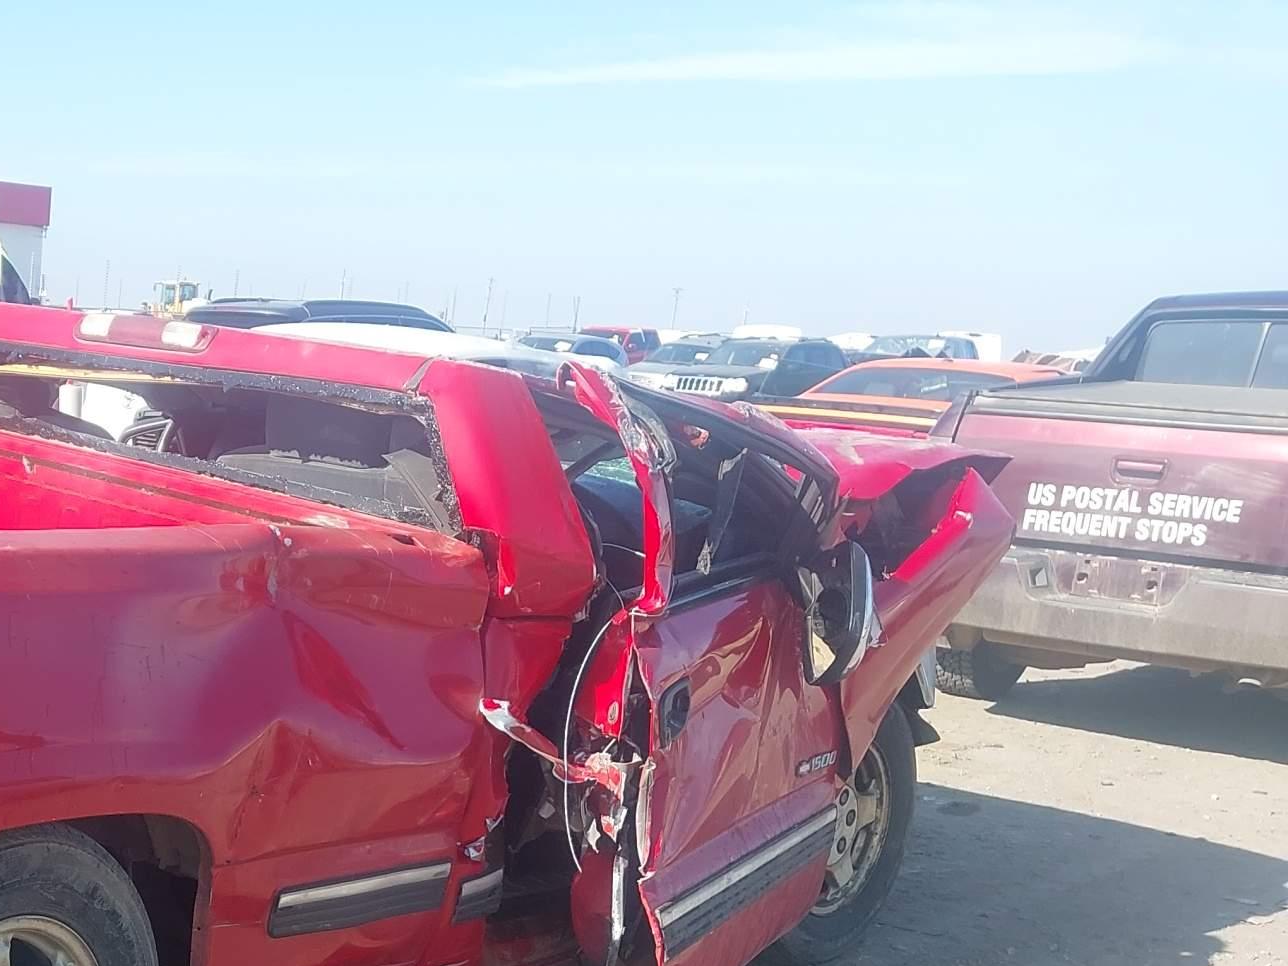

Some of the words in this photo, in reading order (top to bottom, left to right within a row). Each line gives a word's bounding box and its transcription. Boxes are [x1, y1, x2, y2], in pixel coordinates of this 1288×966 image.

[1027, 482, 1057, 506] US
[1060, 487, 1142, 514] POSTAL
[1147, 492, 1244, 523] SERVICE
[1022, 508, 1132, 539] FREQUENT
[1134, 518, 1208, 546] STOPS
[811, 751, 837, 769] 1500
